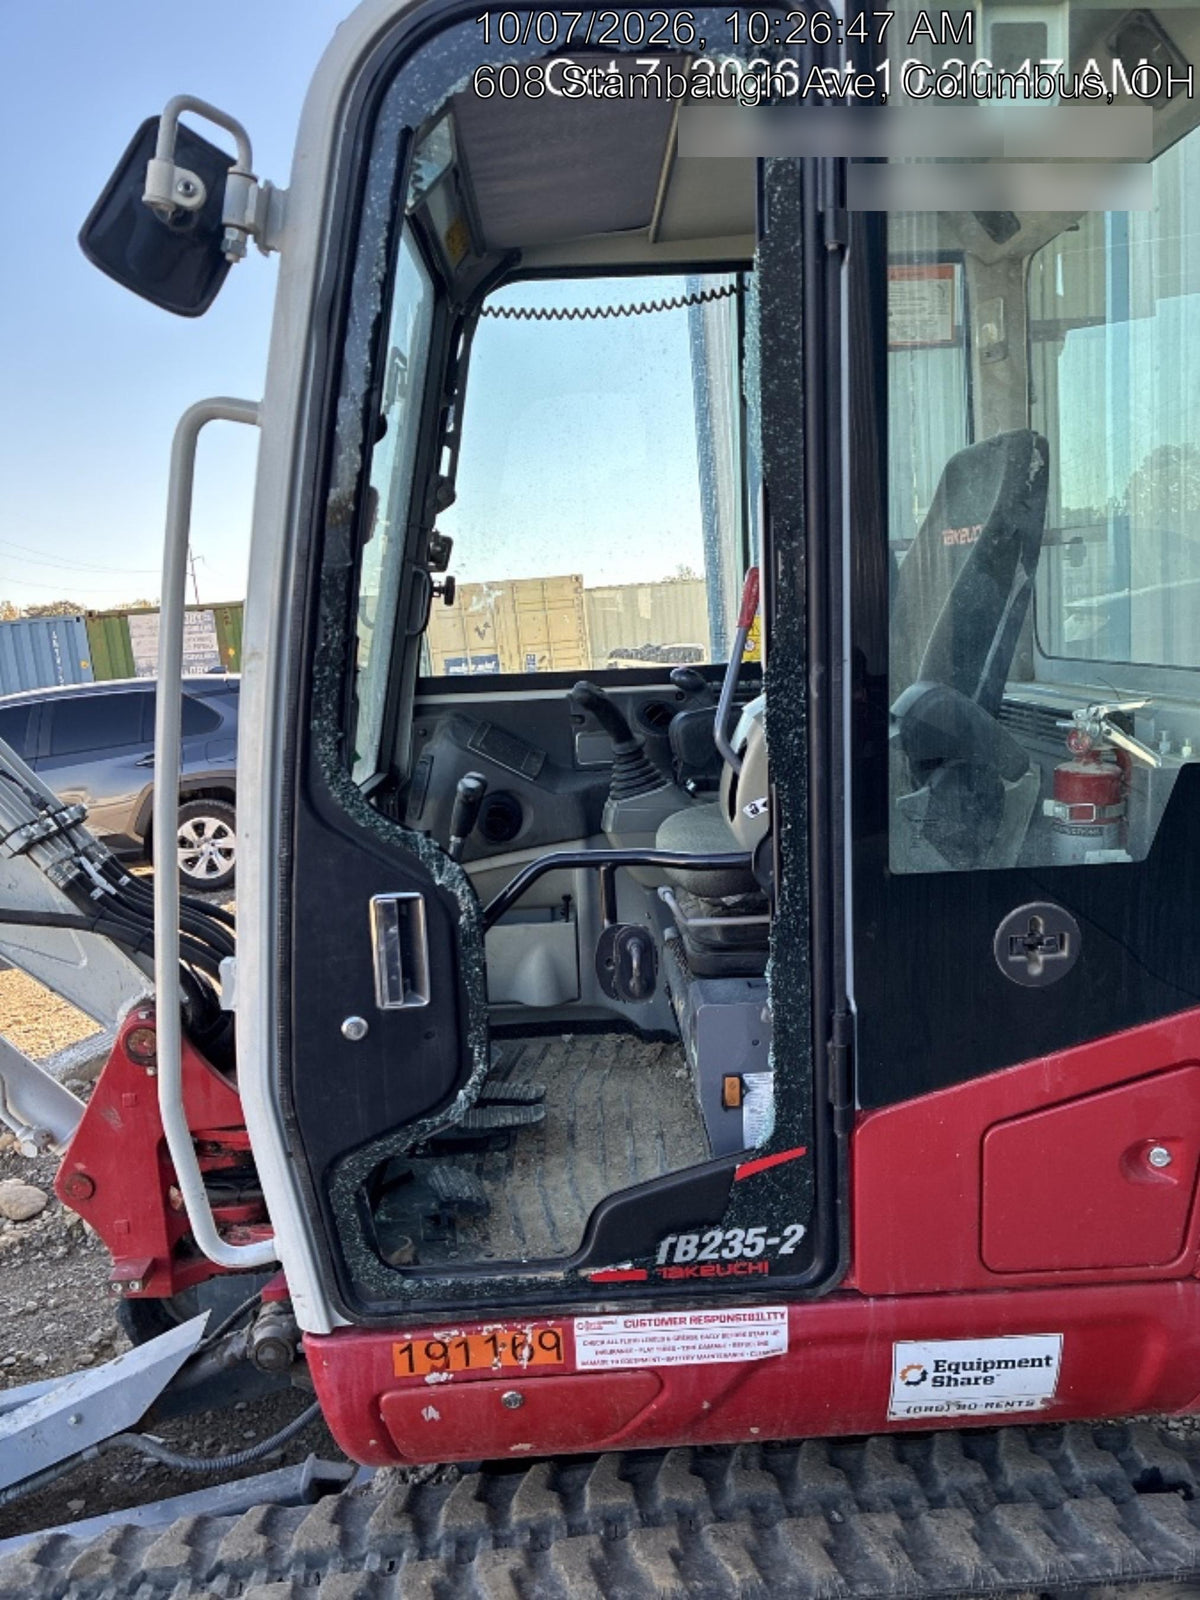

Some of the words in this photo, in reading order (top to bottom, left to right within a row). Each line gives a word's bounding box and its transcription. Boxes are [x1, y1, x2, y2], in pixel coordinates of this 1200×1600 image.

[623, 1316, 688, 1329] CUSTOMER
[689, 1311, 786, 1325] RESPONSIBILITY
[399, 1329, 563, 1373] 191169
[932, 1354, 1053, 1374] Equipment
[931, 1374, 996, 1388] Share
